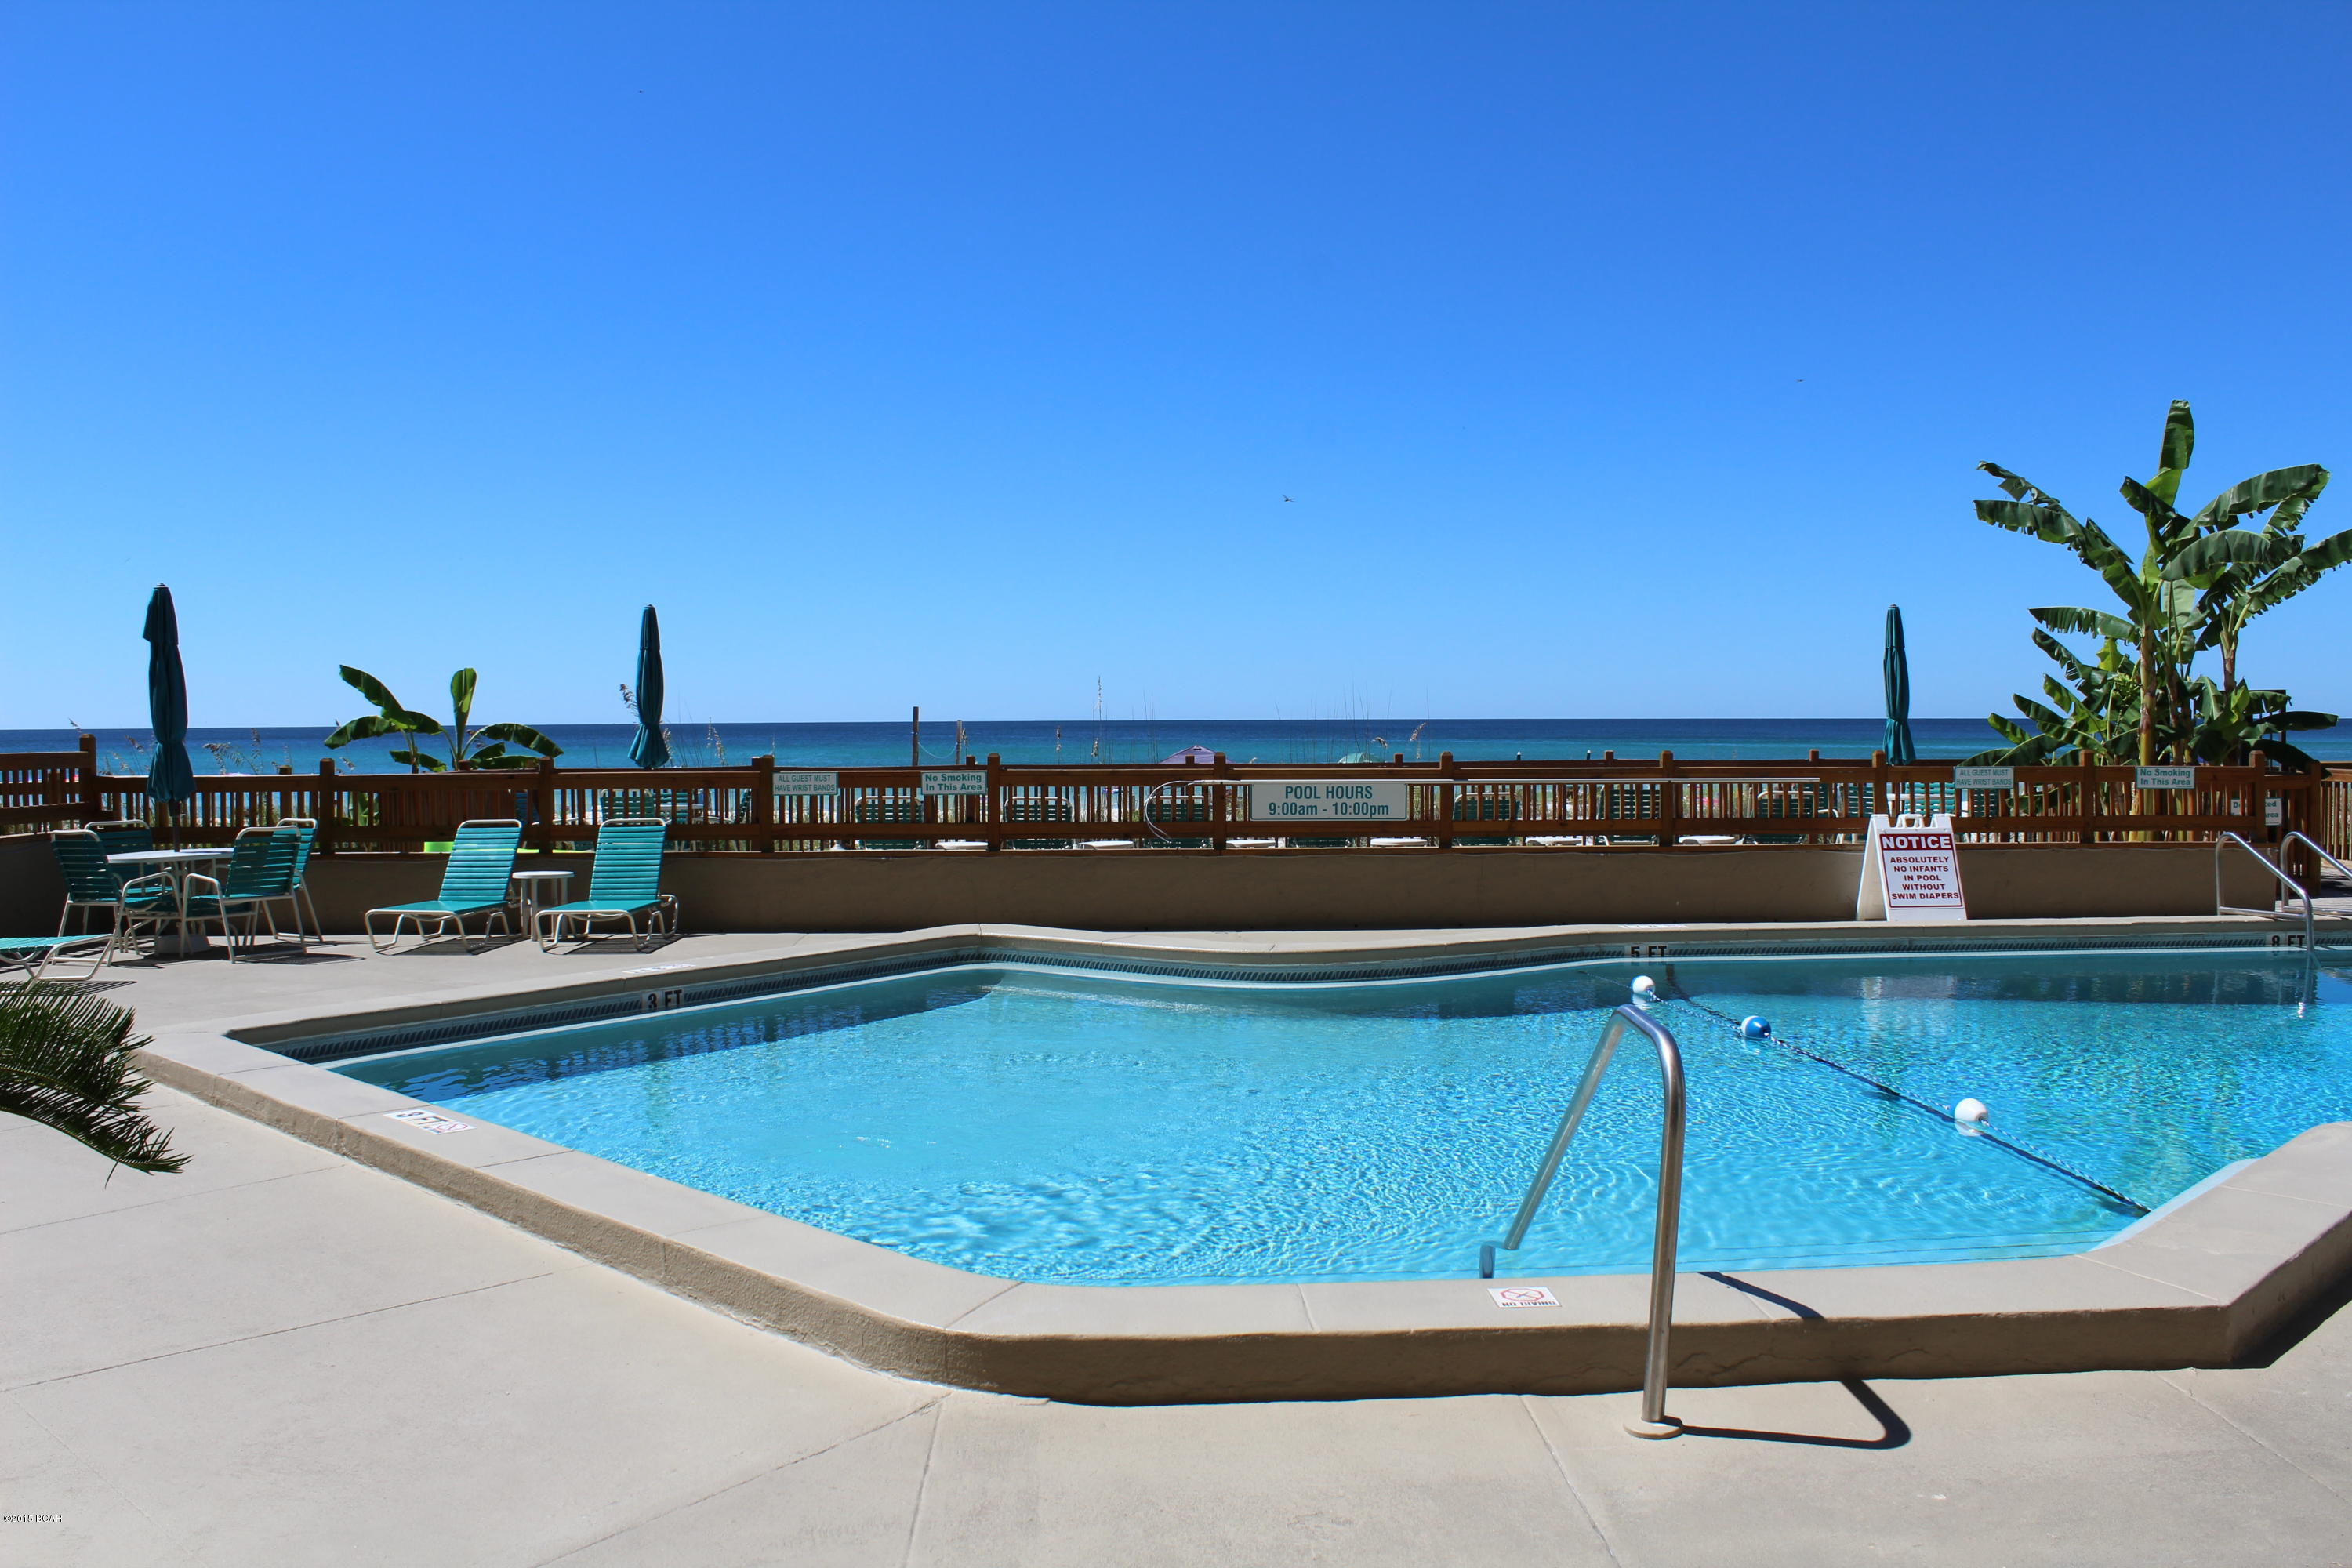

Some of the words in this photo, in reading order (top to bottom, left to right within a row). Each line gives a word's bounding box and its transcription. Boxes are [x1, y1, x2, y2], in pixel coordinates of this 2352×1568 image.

[941, 773, 982, 783] Smoking
[2154, 768, 2190, 778] Smoking
[1285, 786, 1321, 800] POOL
[1326, 786, 1373, 800] HOURS
[1269, 802, 1318, 815] 9:00am
[1332, 802, 1389, 818] 10:00pm
[1882, 836, 1952, 849] NOTICE
[2288, 935, 2305, 947] FT
[1630, 946, 1640, 958] 5
[1648, 946, 1667, 957] FT
[648, 993, 658, 1009] 3
[664, 989, 683, 1008] FT
